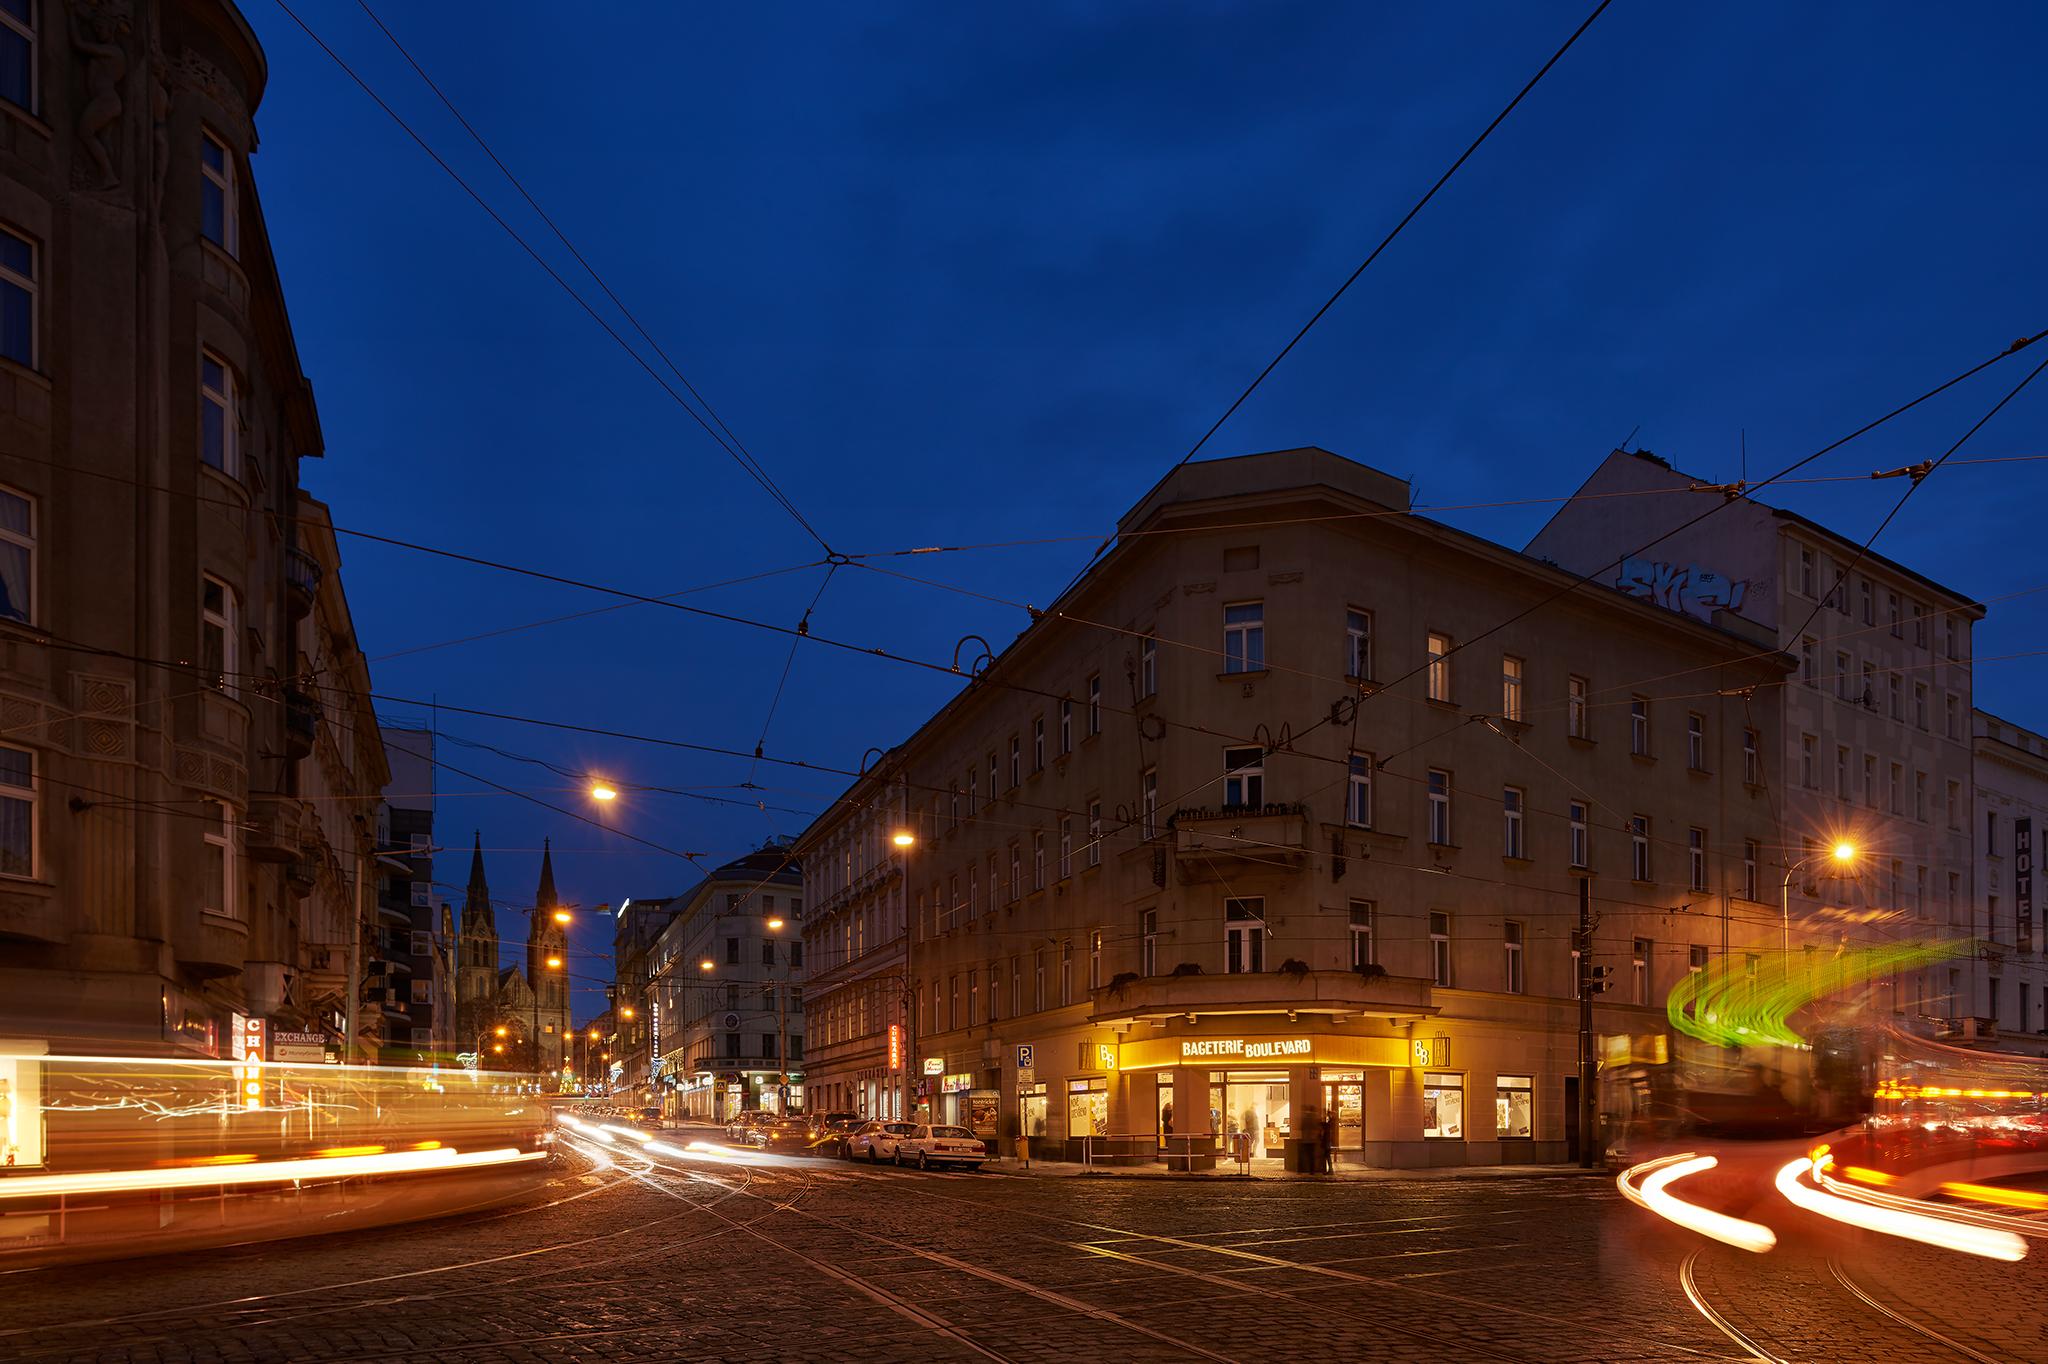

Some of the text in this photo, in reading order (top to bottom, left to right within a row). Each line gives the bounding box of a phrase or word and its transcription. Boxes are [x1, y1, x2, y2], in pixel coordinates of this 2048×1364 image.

[2017, 831, 2030, 940] HOTEL
[274, 1032, 325, 1043] EXCHANGE
[1020, 1048, 1030, 1061] P
[1183, 1039, 1311, 1058] BAGETERIE BOULEVARD
[246, 1019, 261, 1110] CHANGE
